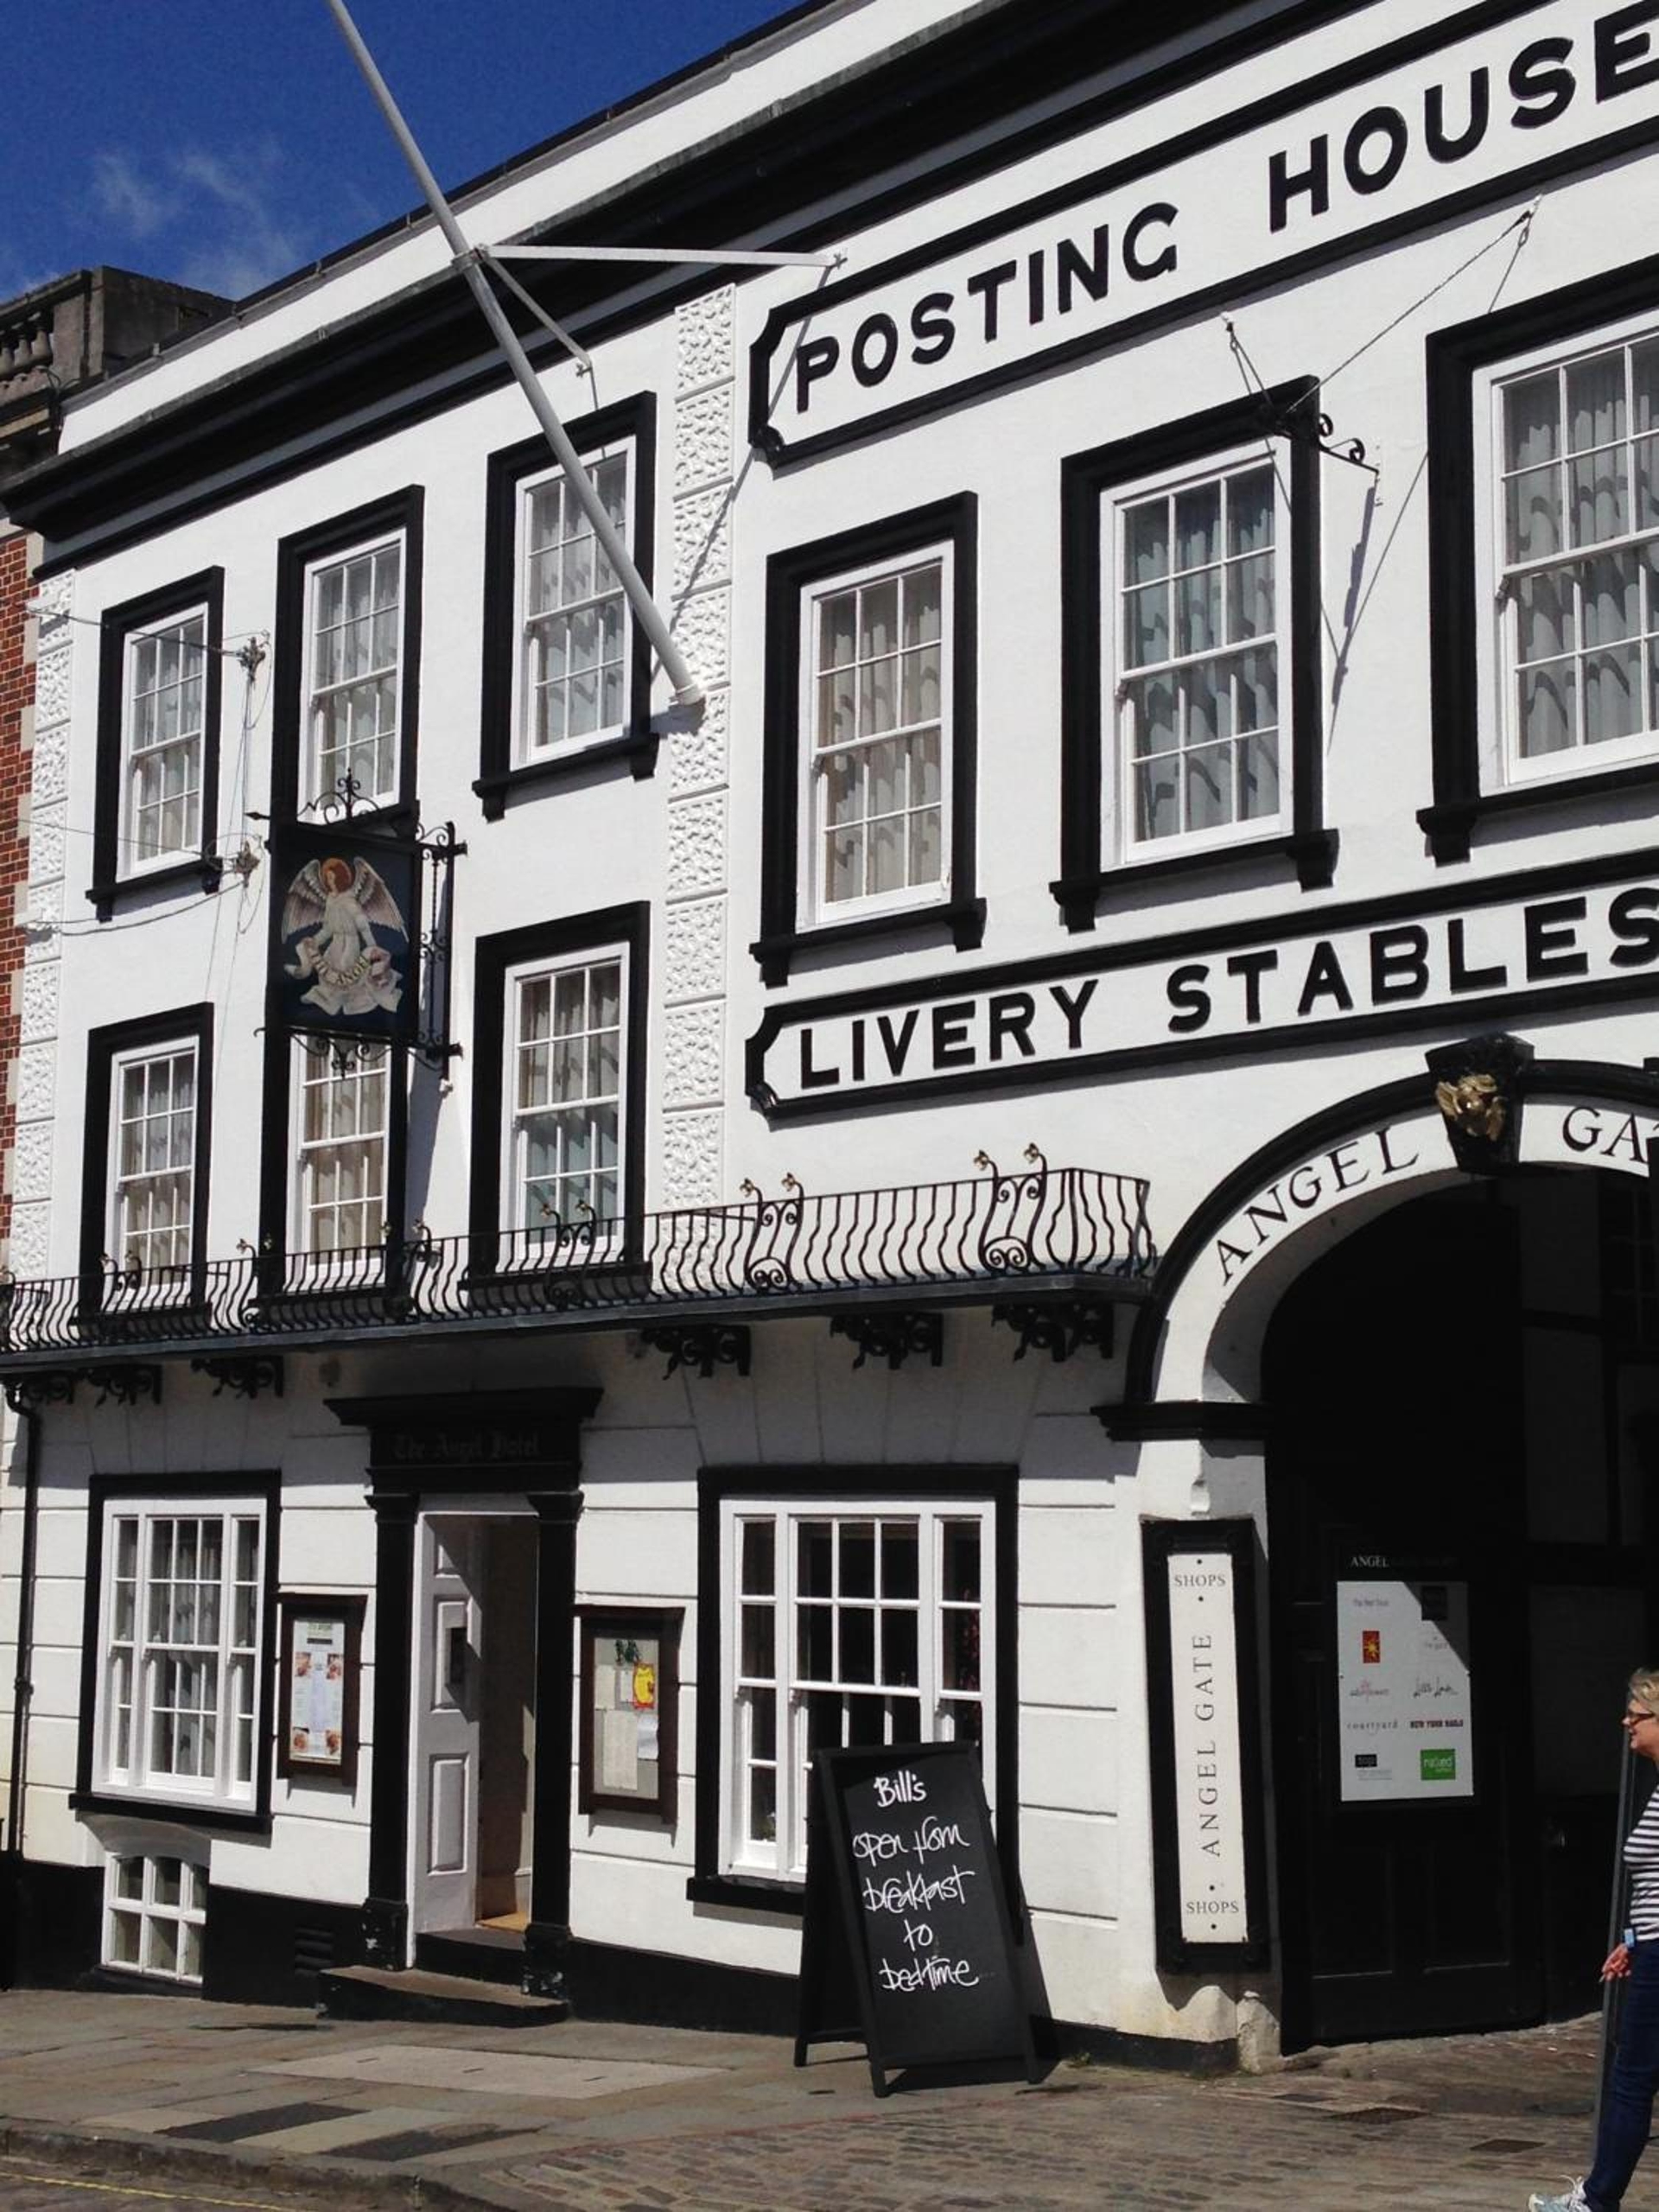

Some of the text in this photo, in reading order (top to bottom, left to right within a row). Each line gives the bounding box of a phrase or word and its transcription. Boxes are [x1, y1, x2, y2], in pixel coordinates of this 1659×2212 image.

[796, 0, 1659, 413] POSTING HOUSE
[800, 887, 1659, 1090] LIVERY STABLES
[1215, 1106, 1659, 1286] ANGEL GA
[1174, 1573, 1226, 1587] SHOPS
[1350, 1555, 1390, 1568] ANGEL
[1192, 1634, 1220, 1858] ANGEL GATE
[873, 1770, 927, 1808] Bill's
[852, 1815, 971, 1867] open from
[862, 1864, 976, 1914] breakfast
[1186, 1901, 1239, 1915] SHOPS
[904, 1919, 934, 1952] to
[878, 1955, 980, 1993] bedtime
